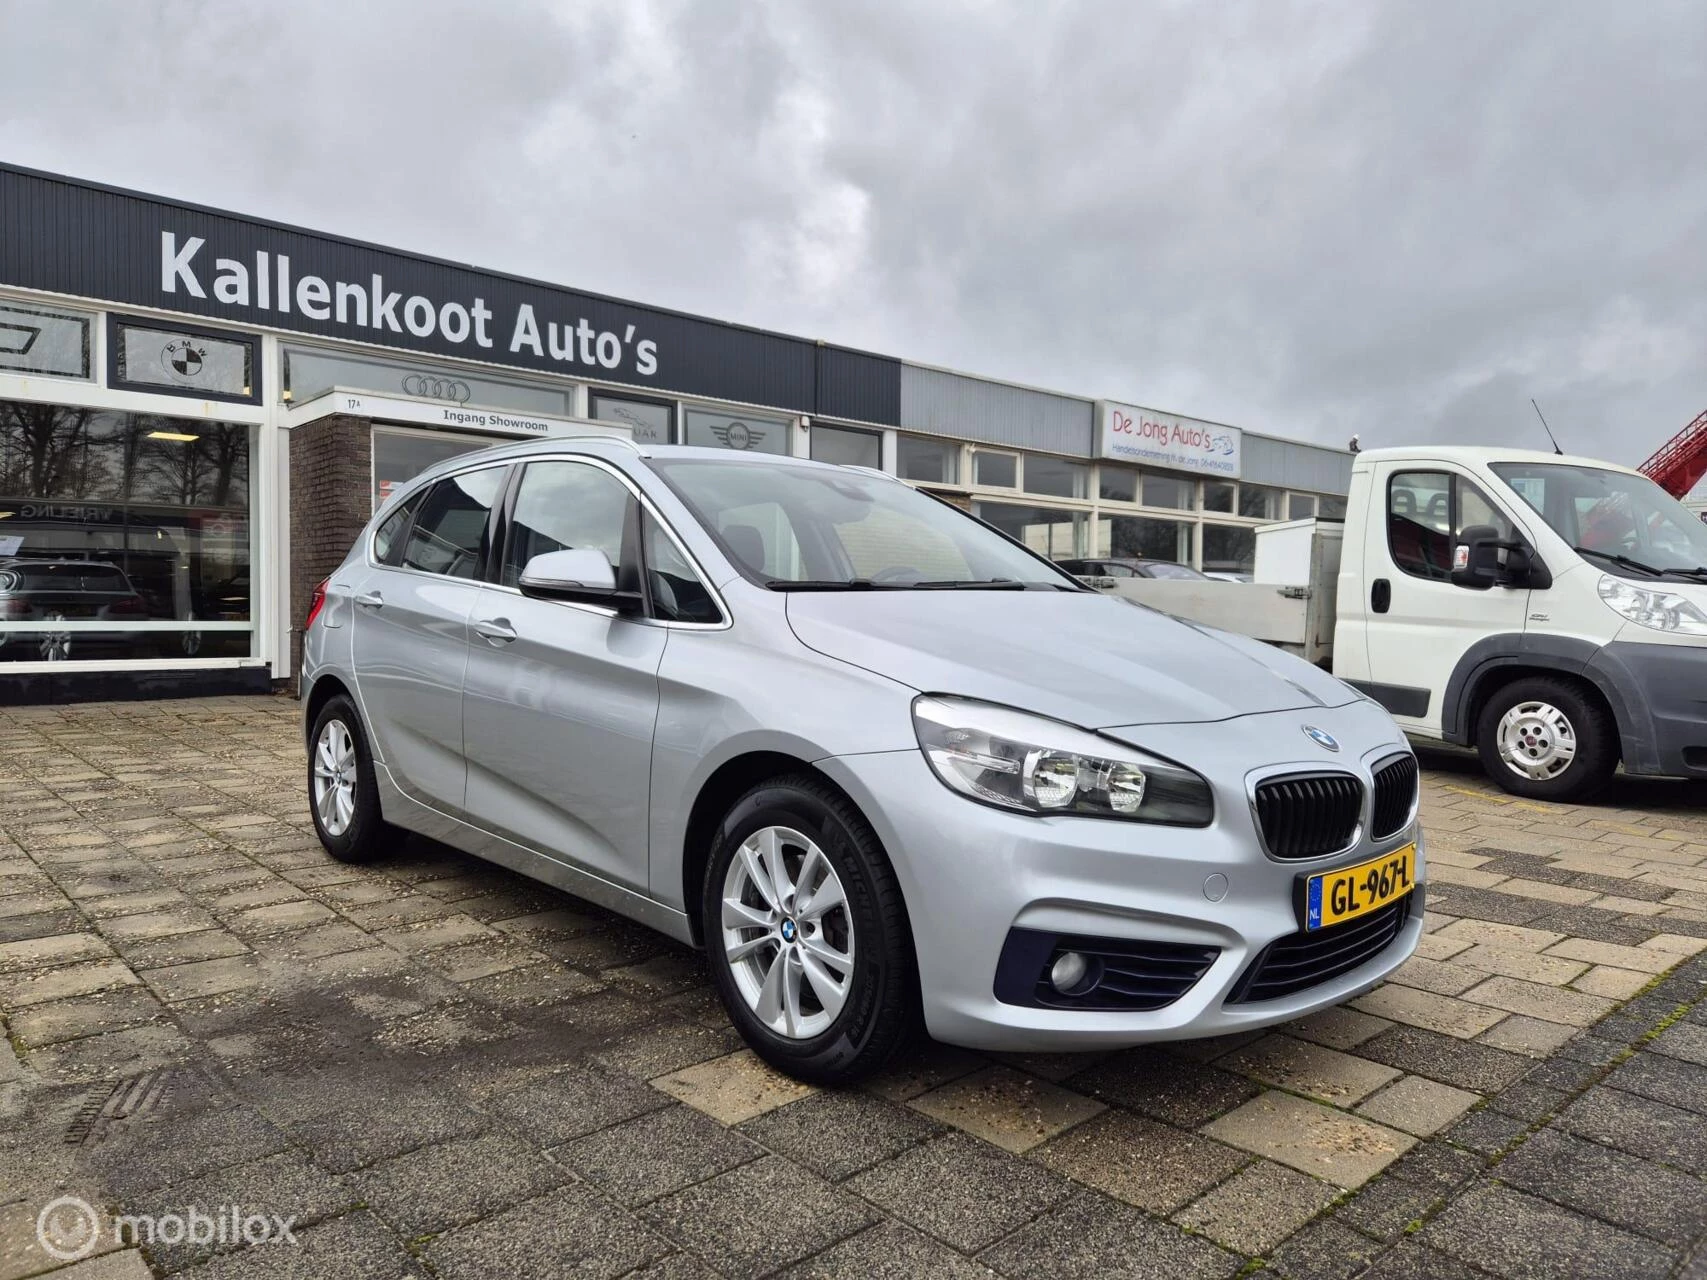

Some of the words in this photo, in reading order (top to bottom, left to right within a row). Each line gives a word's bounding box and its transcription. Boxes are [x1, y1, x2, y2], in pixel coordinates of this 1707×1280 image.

[161, 231, 493, 348] Kallenkoot
[510, 303, 658, 376] Auto's
[167, 340, 207, 357] BMW
[443, 410, 486, 426] Ingang
[490, 415, 549, 431] Showroom
[1112, 411, 1132, 434] De
[1136, 416, 1168, 446] Jong
[1171, 424, 1210, 449] Auto's
[730, 431, 747, 441] MINI
[1331, 855, 1411, 917] GL-967-L
[1309, 907, 1320, 921] NL
